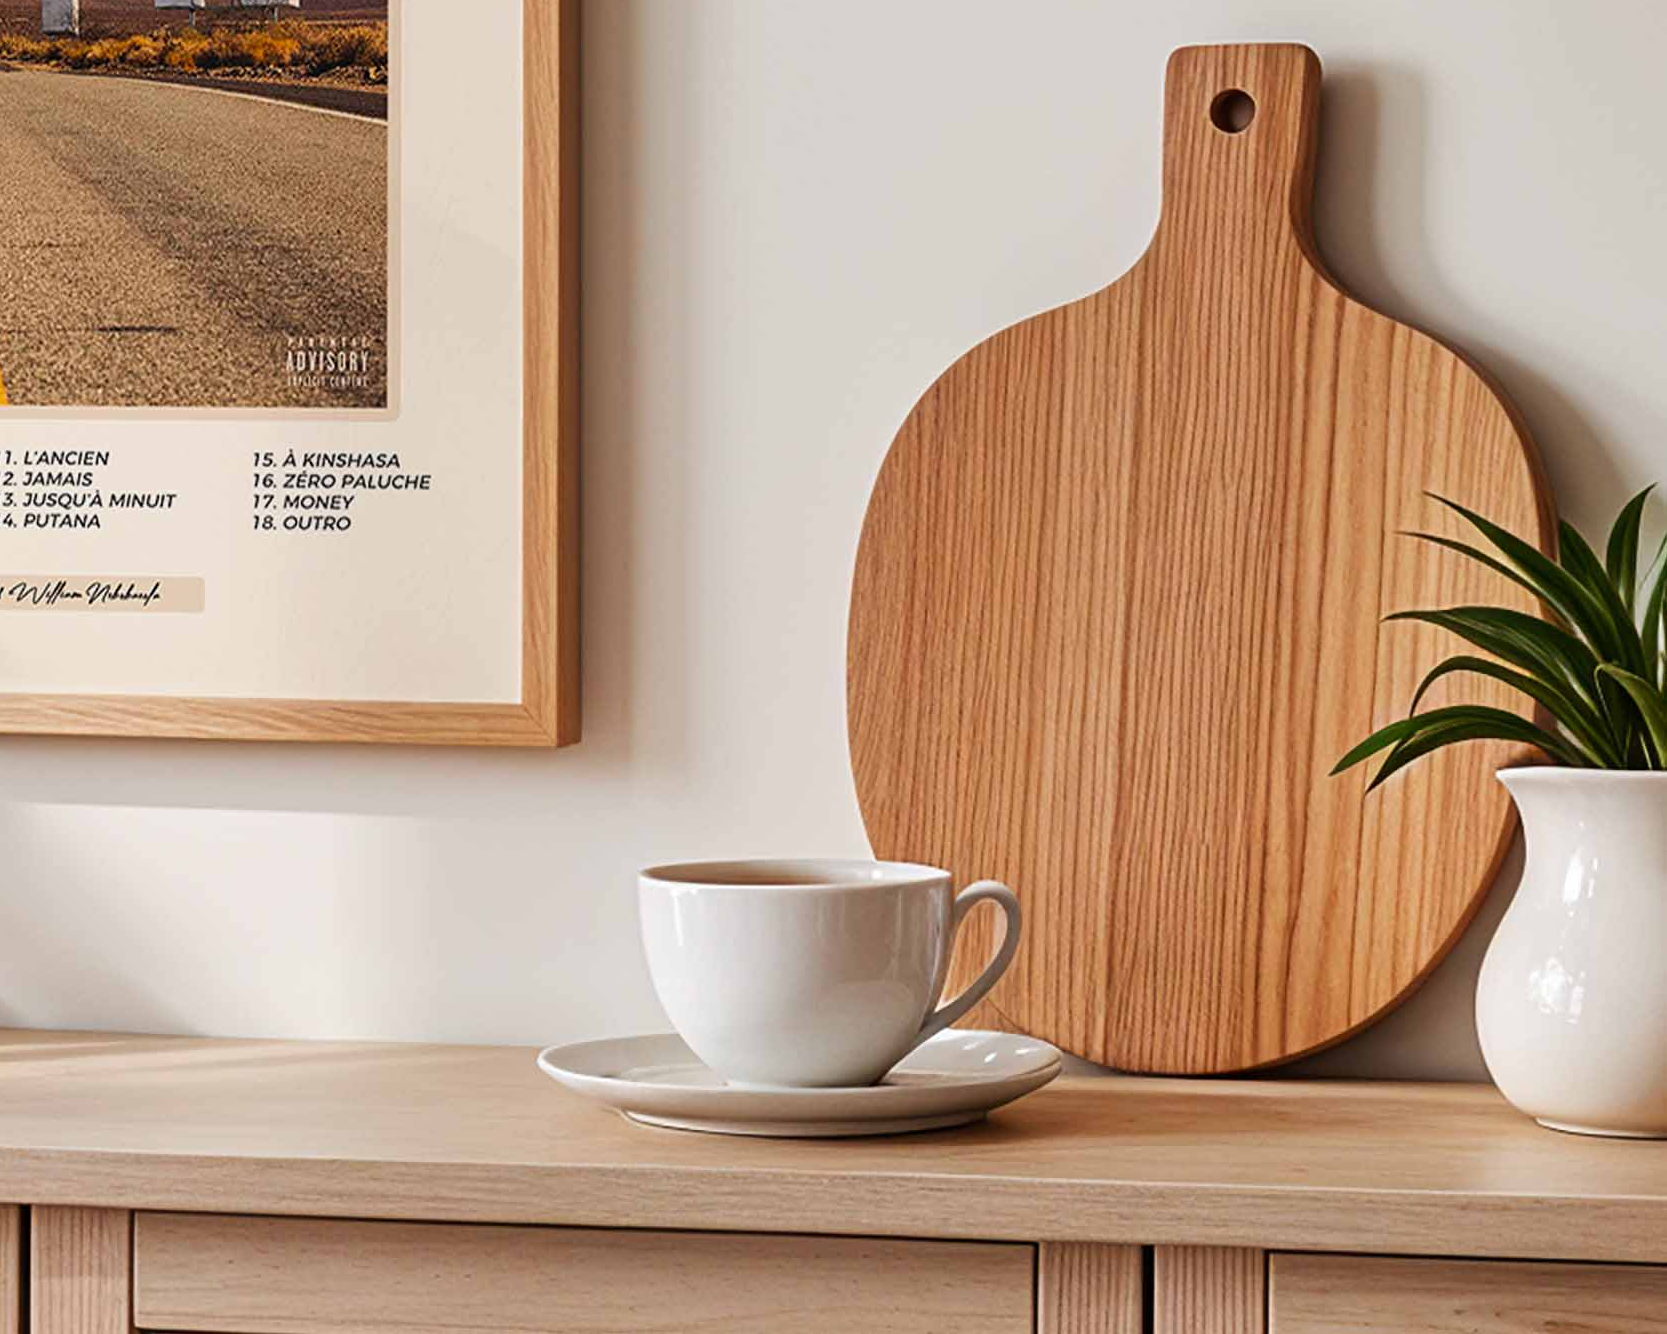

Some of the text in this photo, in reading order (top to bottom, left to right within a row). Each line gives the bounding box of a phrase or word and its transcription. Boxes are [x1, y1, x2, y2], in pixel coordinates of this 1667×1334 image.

[286, 350, 369, 372] ADVISORY
[253, 449, 401, 470] 15. À KINSHASA
[22, 471, 94, 487] JAMAIS
[253, 470, 432, 490] 16. ZÉRO PALUCHE
[108, 493, 178, 508] MINUIT
[253, 494, 355, 511] 17. MONEY
[23, 513, 101, 529] PUTANA
[253, 514, 352, 531] 18. OUTRO
